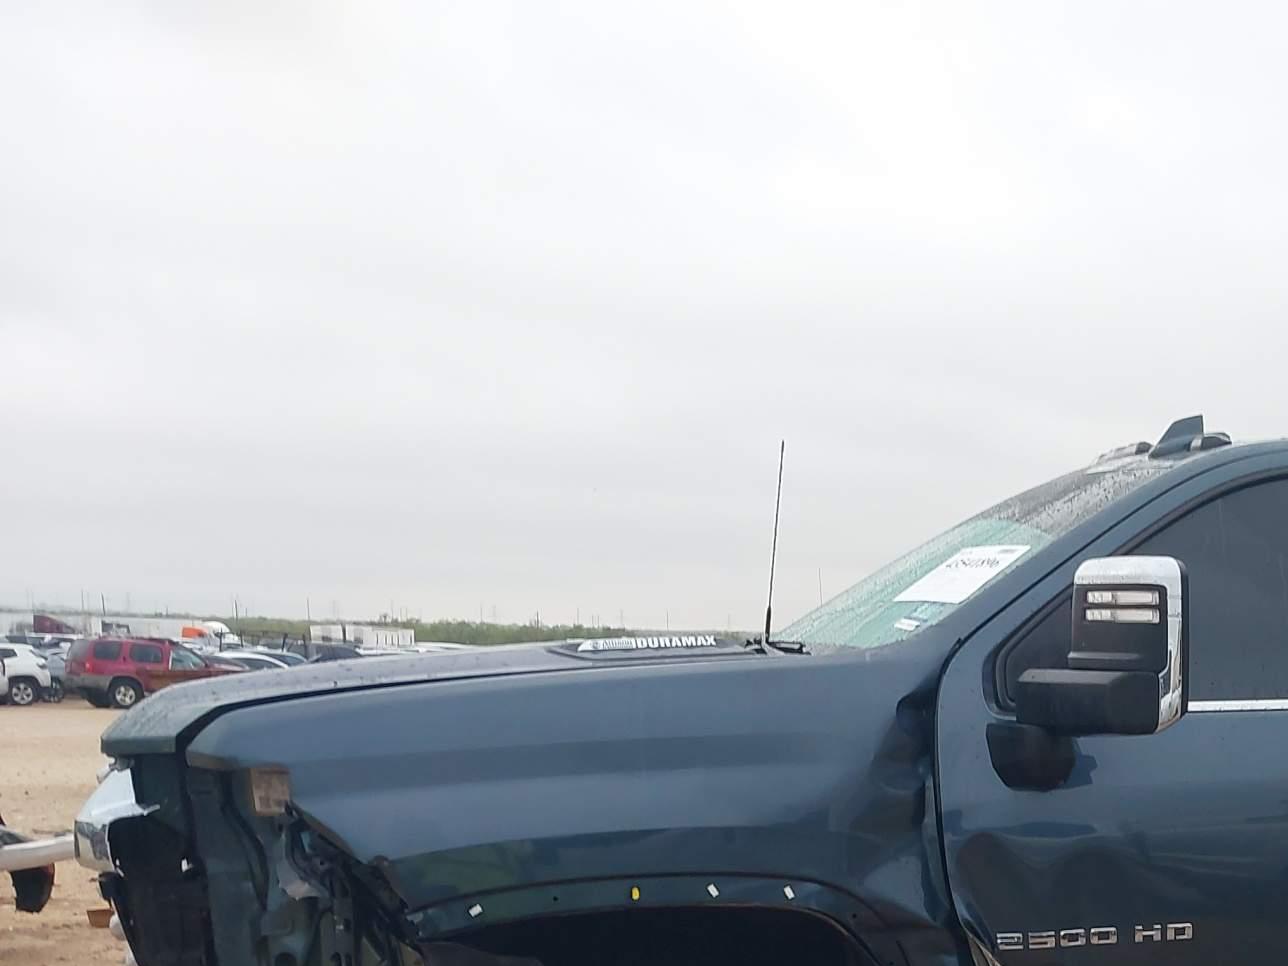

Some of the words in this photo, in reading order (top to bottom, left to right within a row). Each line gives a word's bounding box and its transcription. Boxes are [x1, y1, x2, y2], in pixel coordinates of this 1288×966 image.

[636, 635, 717, 649] DURAMAX
[996, 926, 1118, 950] 2500
[1134, 922, 1193, 943] HD
